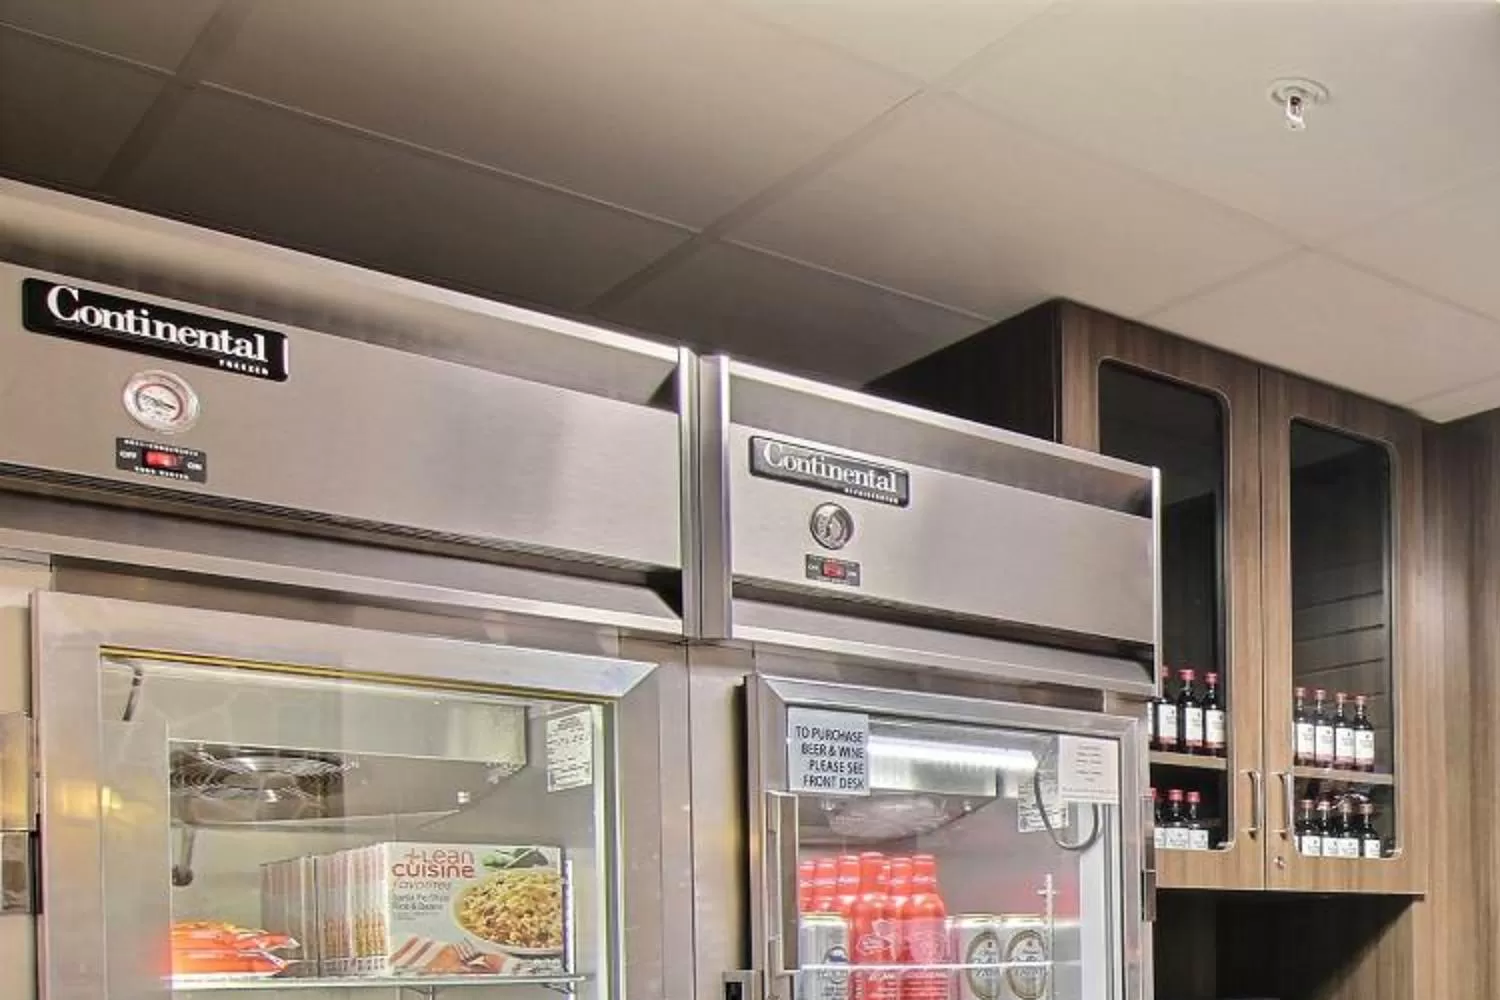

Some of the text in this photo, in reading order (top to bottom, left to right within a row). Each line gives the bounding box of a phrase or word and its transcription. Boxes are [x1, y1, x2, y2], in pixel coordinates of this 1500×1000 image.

[46, 284, 269, 363] Continental
[763, 441, 897, 493] Continental
[795, 725, 863, 742] TO PURCHASE
[801, 743, 863, 758] BEER & WINE
[809, 759, 864, 775] PLEASE SEE
[803, 774, 864, 790] FRONT DESK
[391, 863, 476, 879] cuisine
